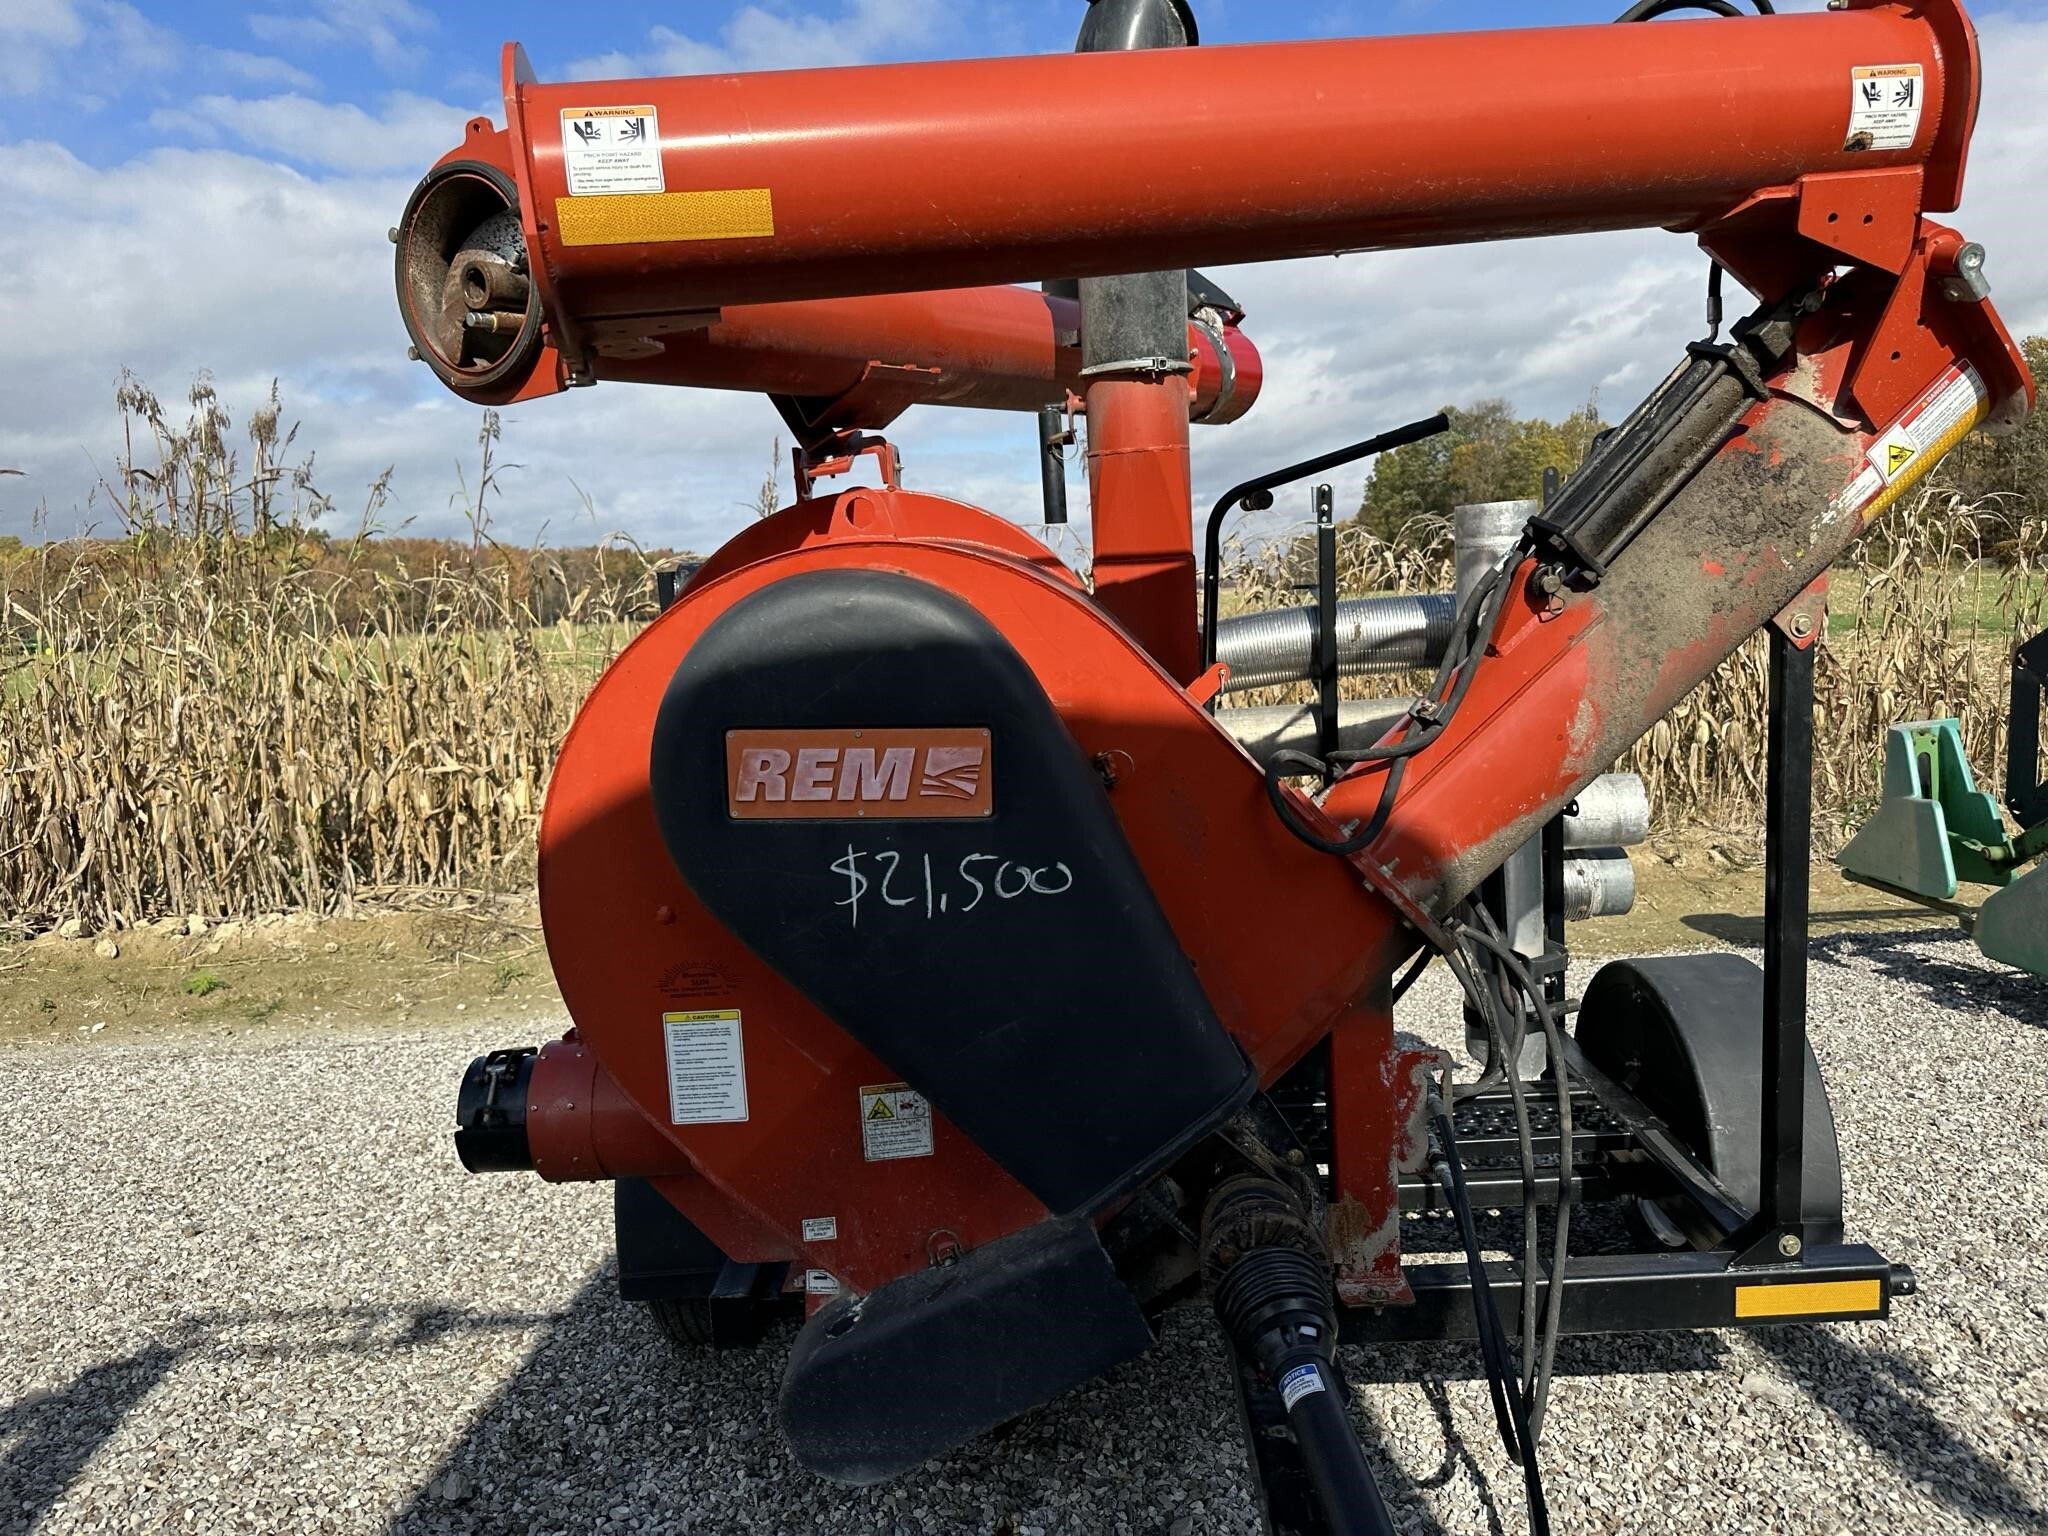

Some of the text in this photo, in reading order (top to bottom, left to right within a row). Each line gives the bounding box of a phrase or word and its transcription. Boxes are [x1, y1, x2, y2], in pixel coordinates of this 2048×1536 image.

[1926, 379, 1950, 402] DANGER
[736, 747, 916, 801] REM
[829, 843, 1073, 928] $21,500
[1284, 1368, 1306, 1385] NOTICE
